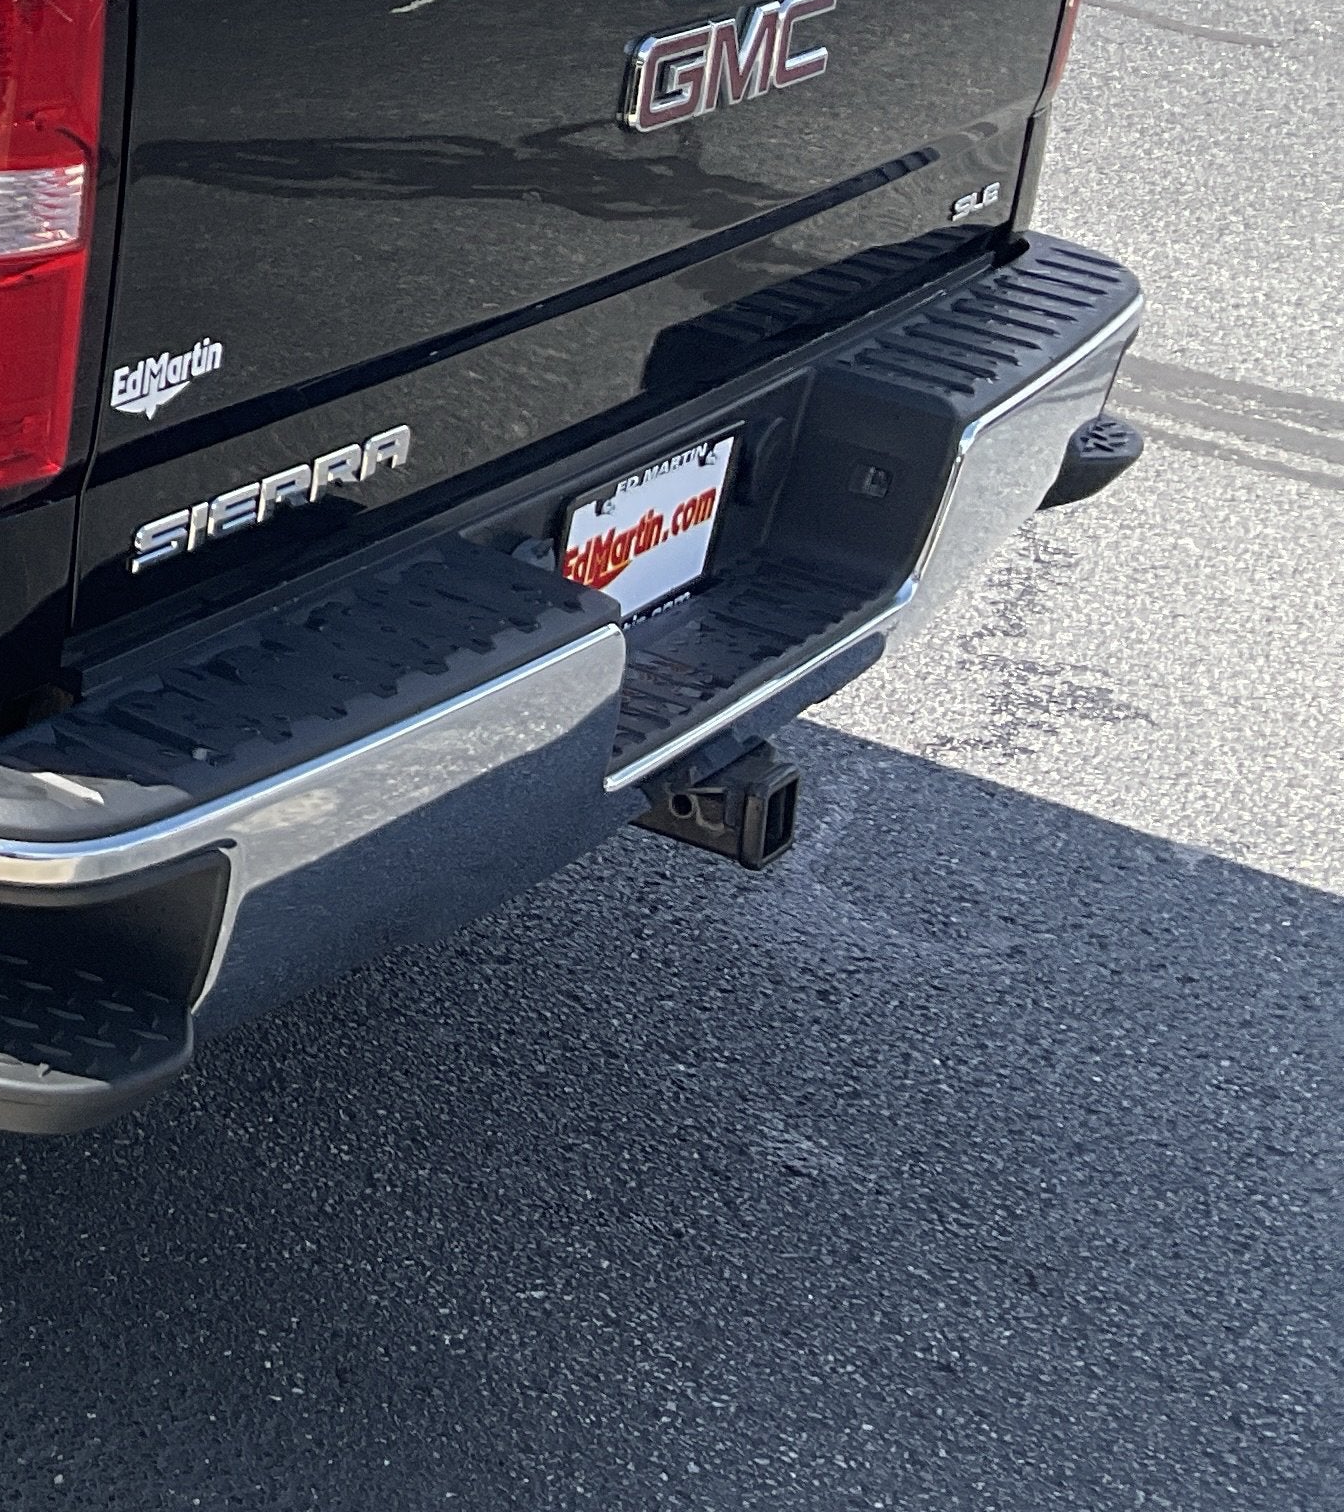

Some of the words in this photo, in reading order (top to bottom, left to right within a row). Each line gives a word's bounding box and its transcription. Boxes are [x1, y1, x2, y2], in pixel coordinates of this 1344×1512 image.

[952, 181, 1001, 222] SLE
[128, 423, 411, 574] SIERRA
[642, 442, 708, 486] MARTIN
[563, 487, 717, 585] EdMartin.com
